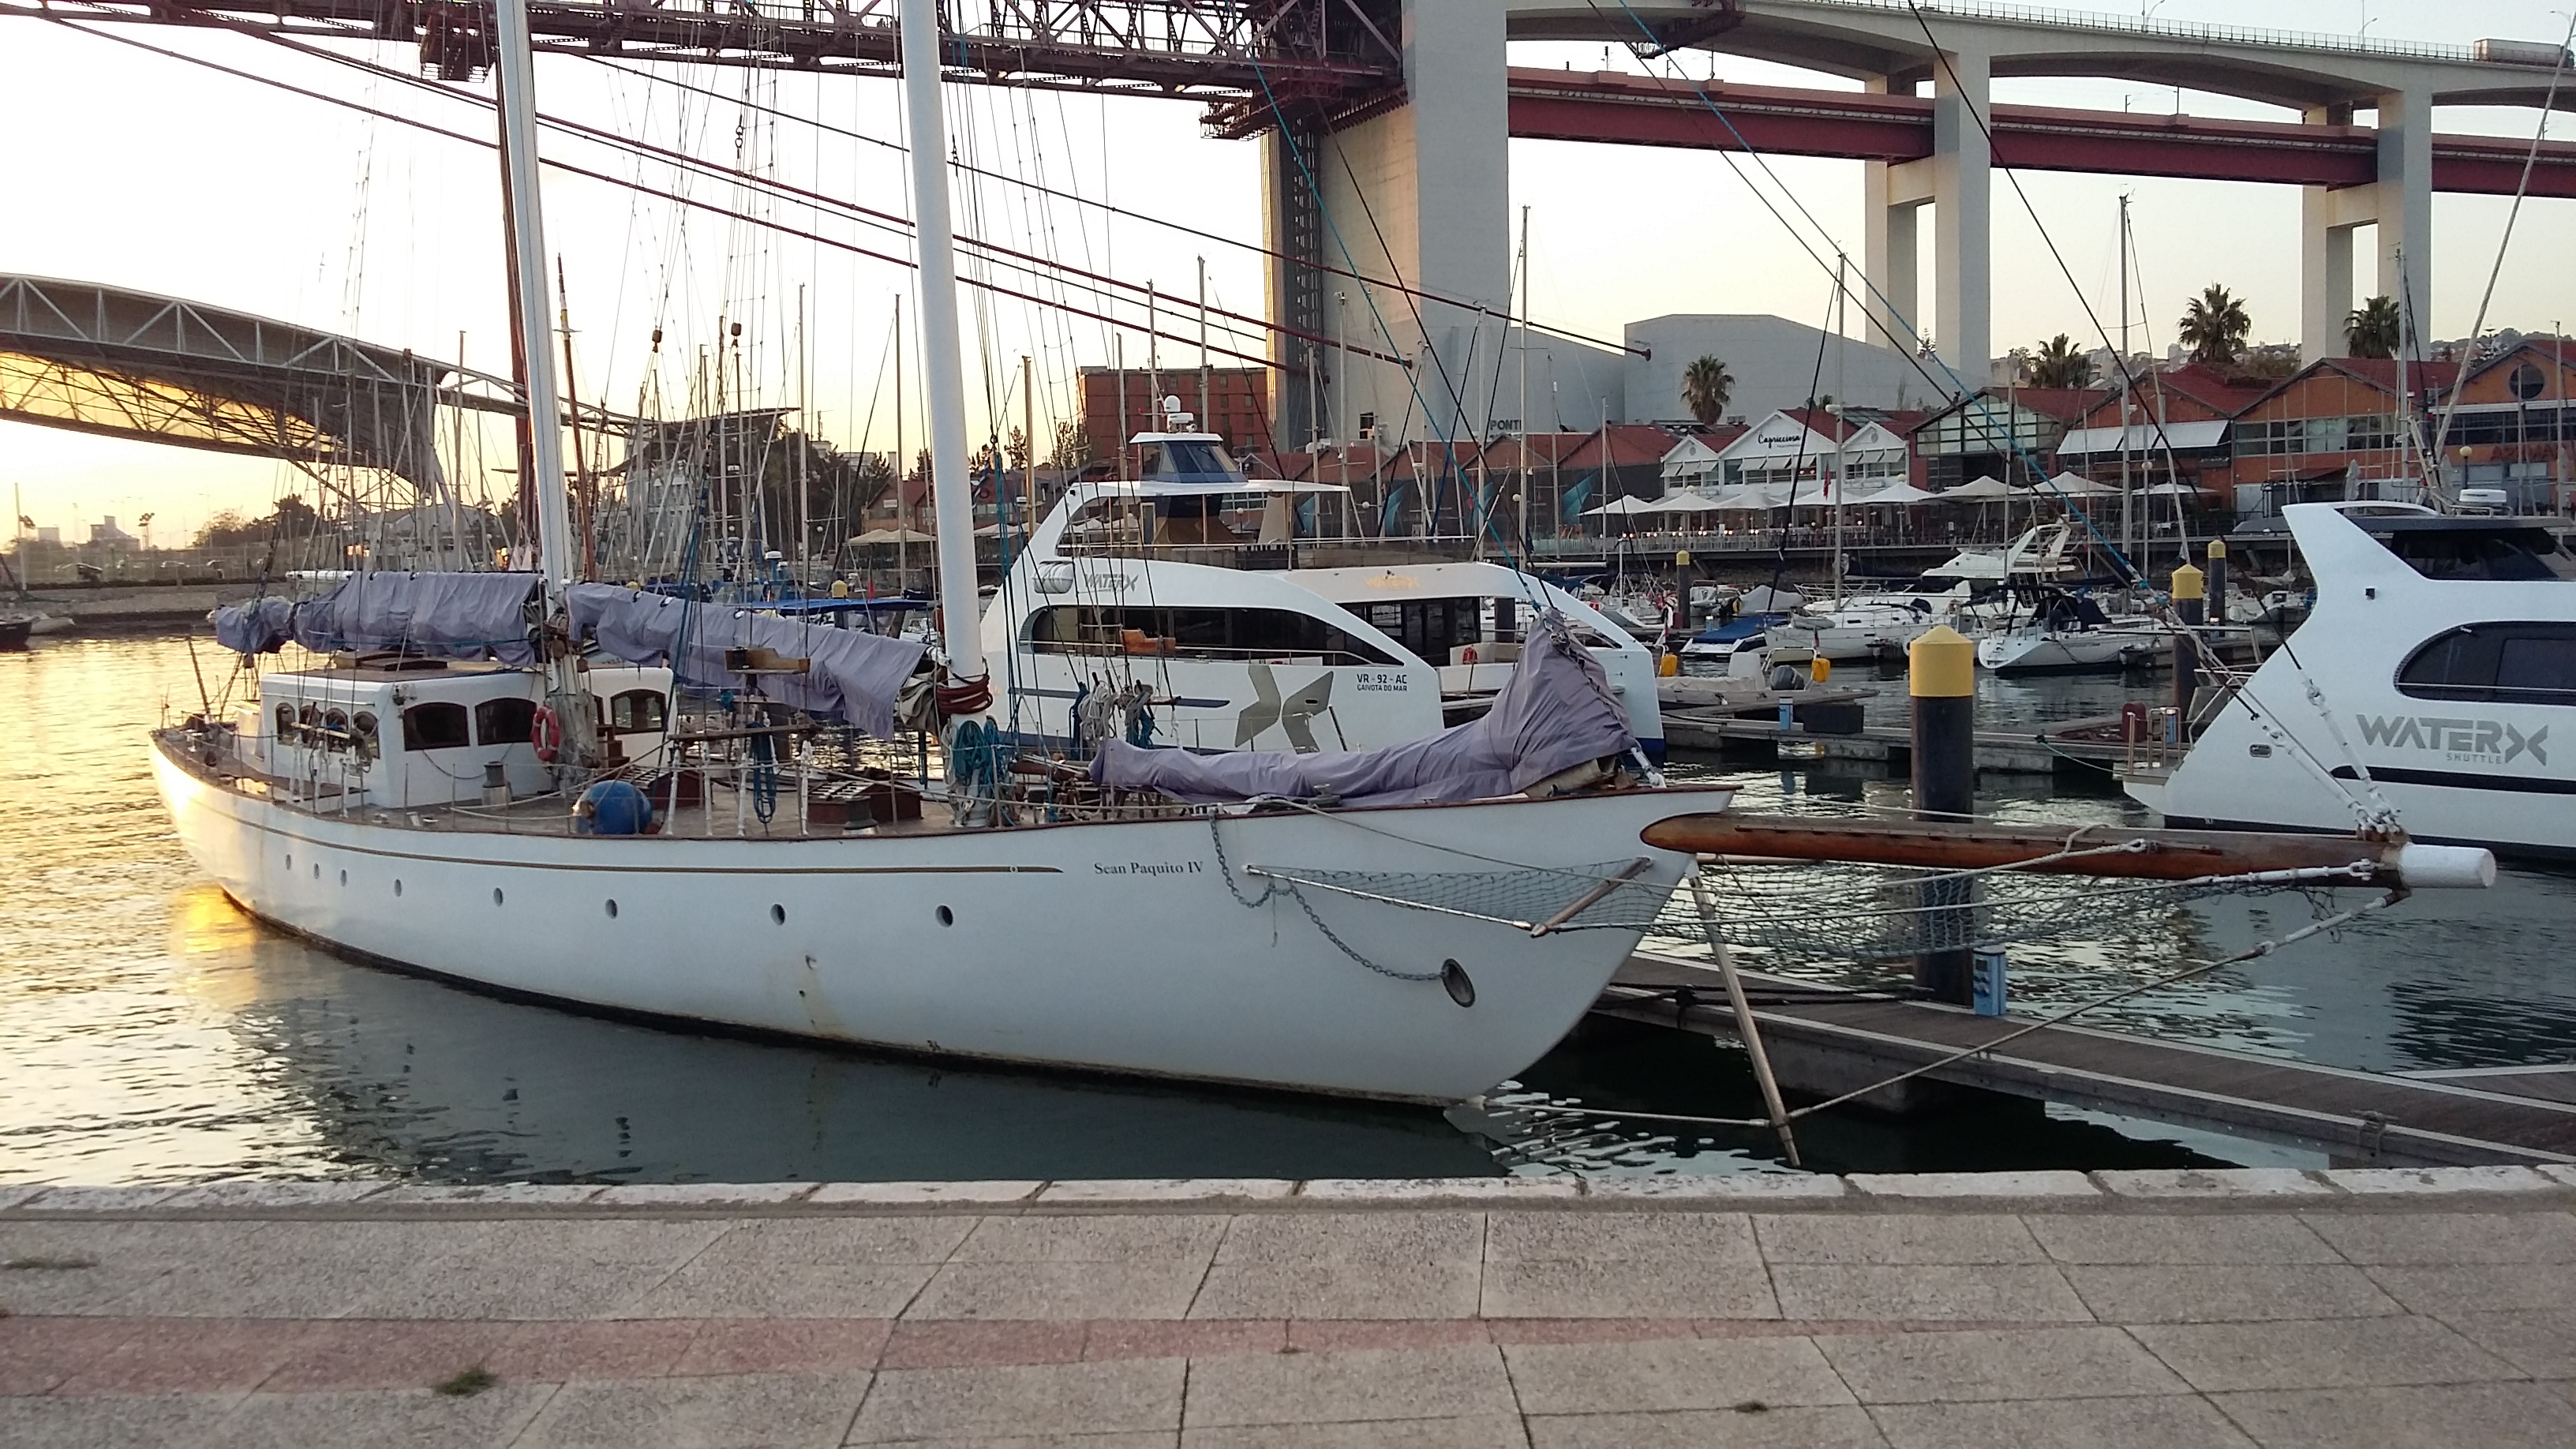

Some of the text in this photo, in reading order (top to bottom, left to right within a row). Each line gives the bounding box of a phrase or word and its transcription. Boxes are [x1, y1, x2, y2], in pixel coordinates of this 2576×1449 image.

[1758, 433, 1801, 448] Capricciosa
[1357, 673, 1369, 683] VR
[1377, 674, 1387, 683] 92
[1395, 674, 1407, 684] AC
[2356, 713, 2549, 767] WATERX
[2447, 752, 2502, 765] SHUTTLE
[1130, 861, 1184, 877] Paquito
[1188, 860, 1204, 873] IV
